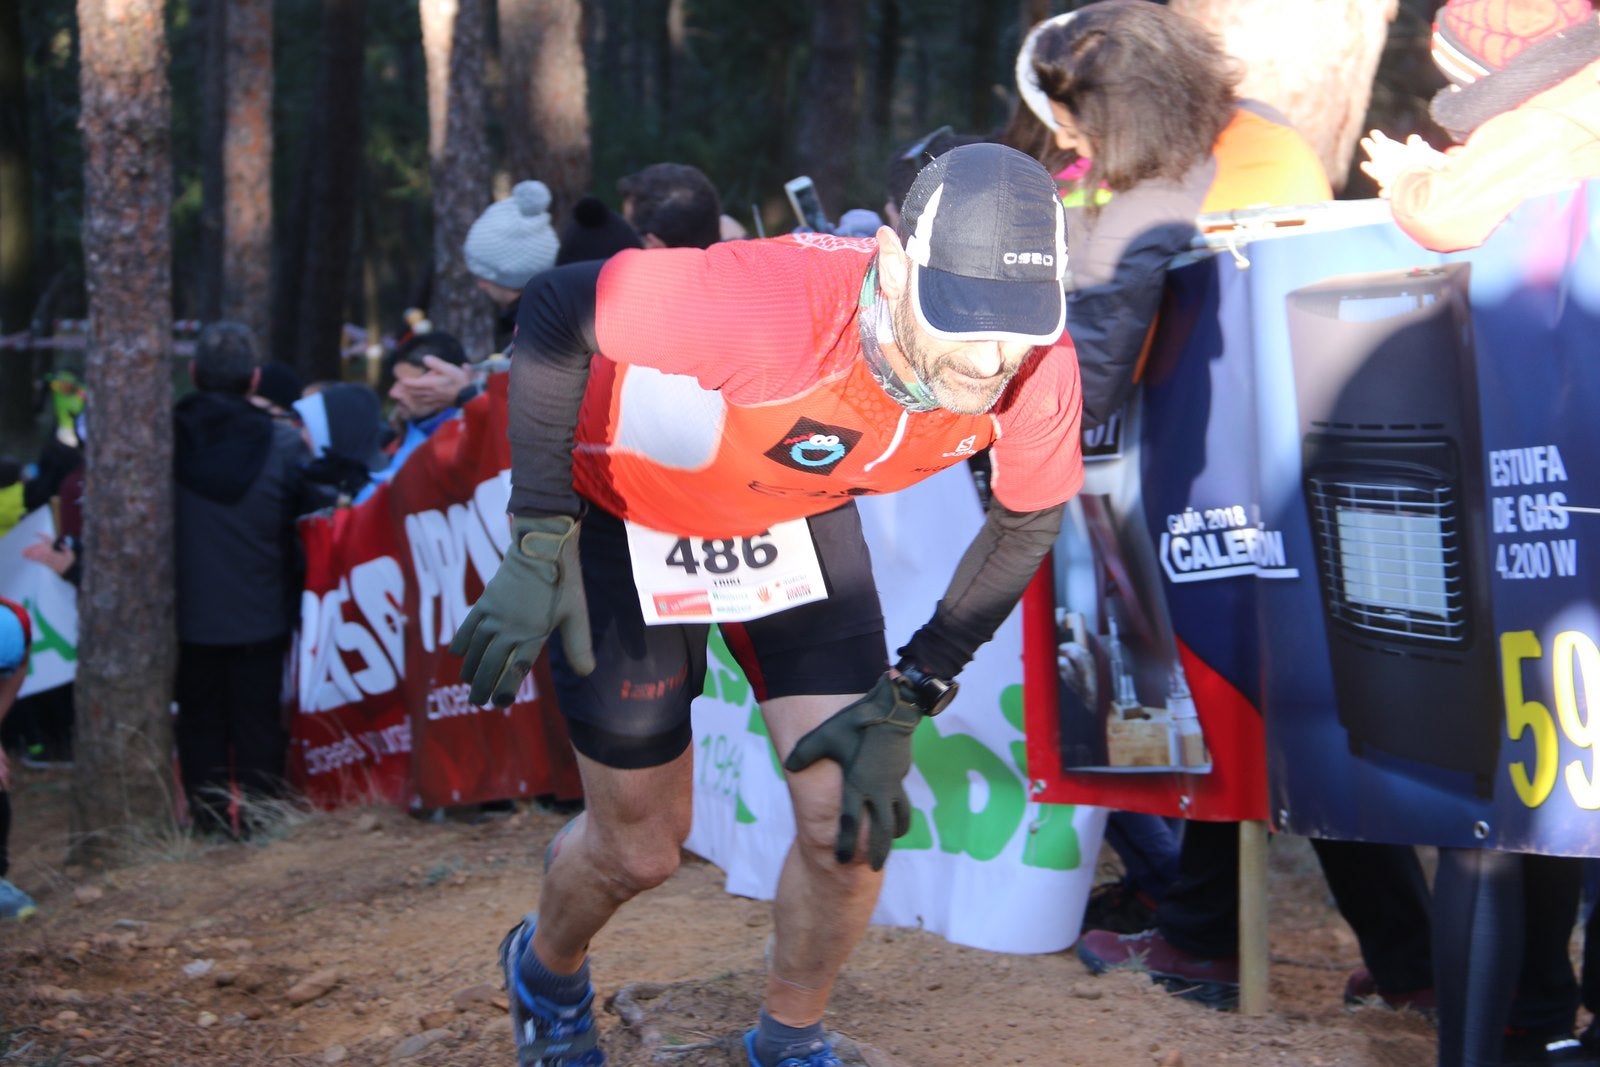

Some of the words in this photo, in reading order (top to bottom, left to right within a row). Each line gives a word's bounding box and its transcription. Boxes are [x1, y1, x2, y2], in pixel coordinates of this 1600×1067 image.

[1488, 444, 1568, 487] ESTUFA
[1204, 505, 1248, 531] 2018
[1492, 496, 1519, 534] DE
[1518, 491, 1570, 532] GAS
[665, 528, 779, 575] 486
[1549, 538, 1577, 577] W
